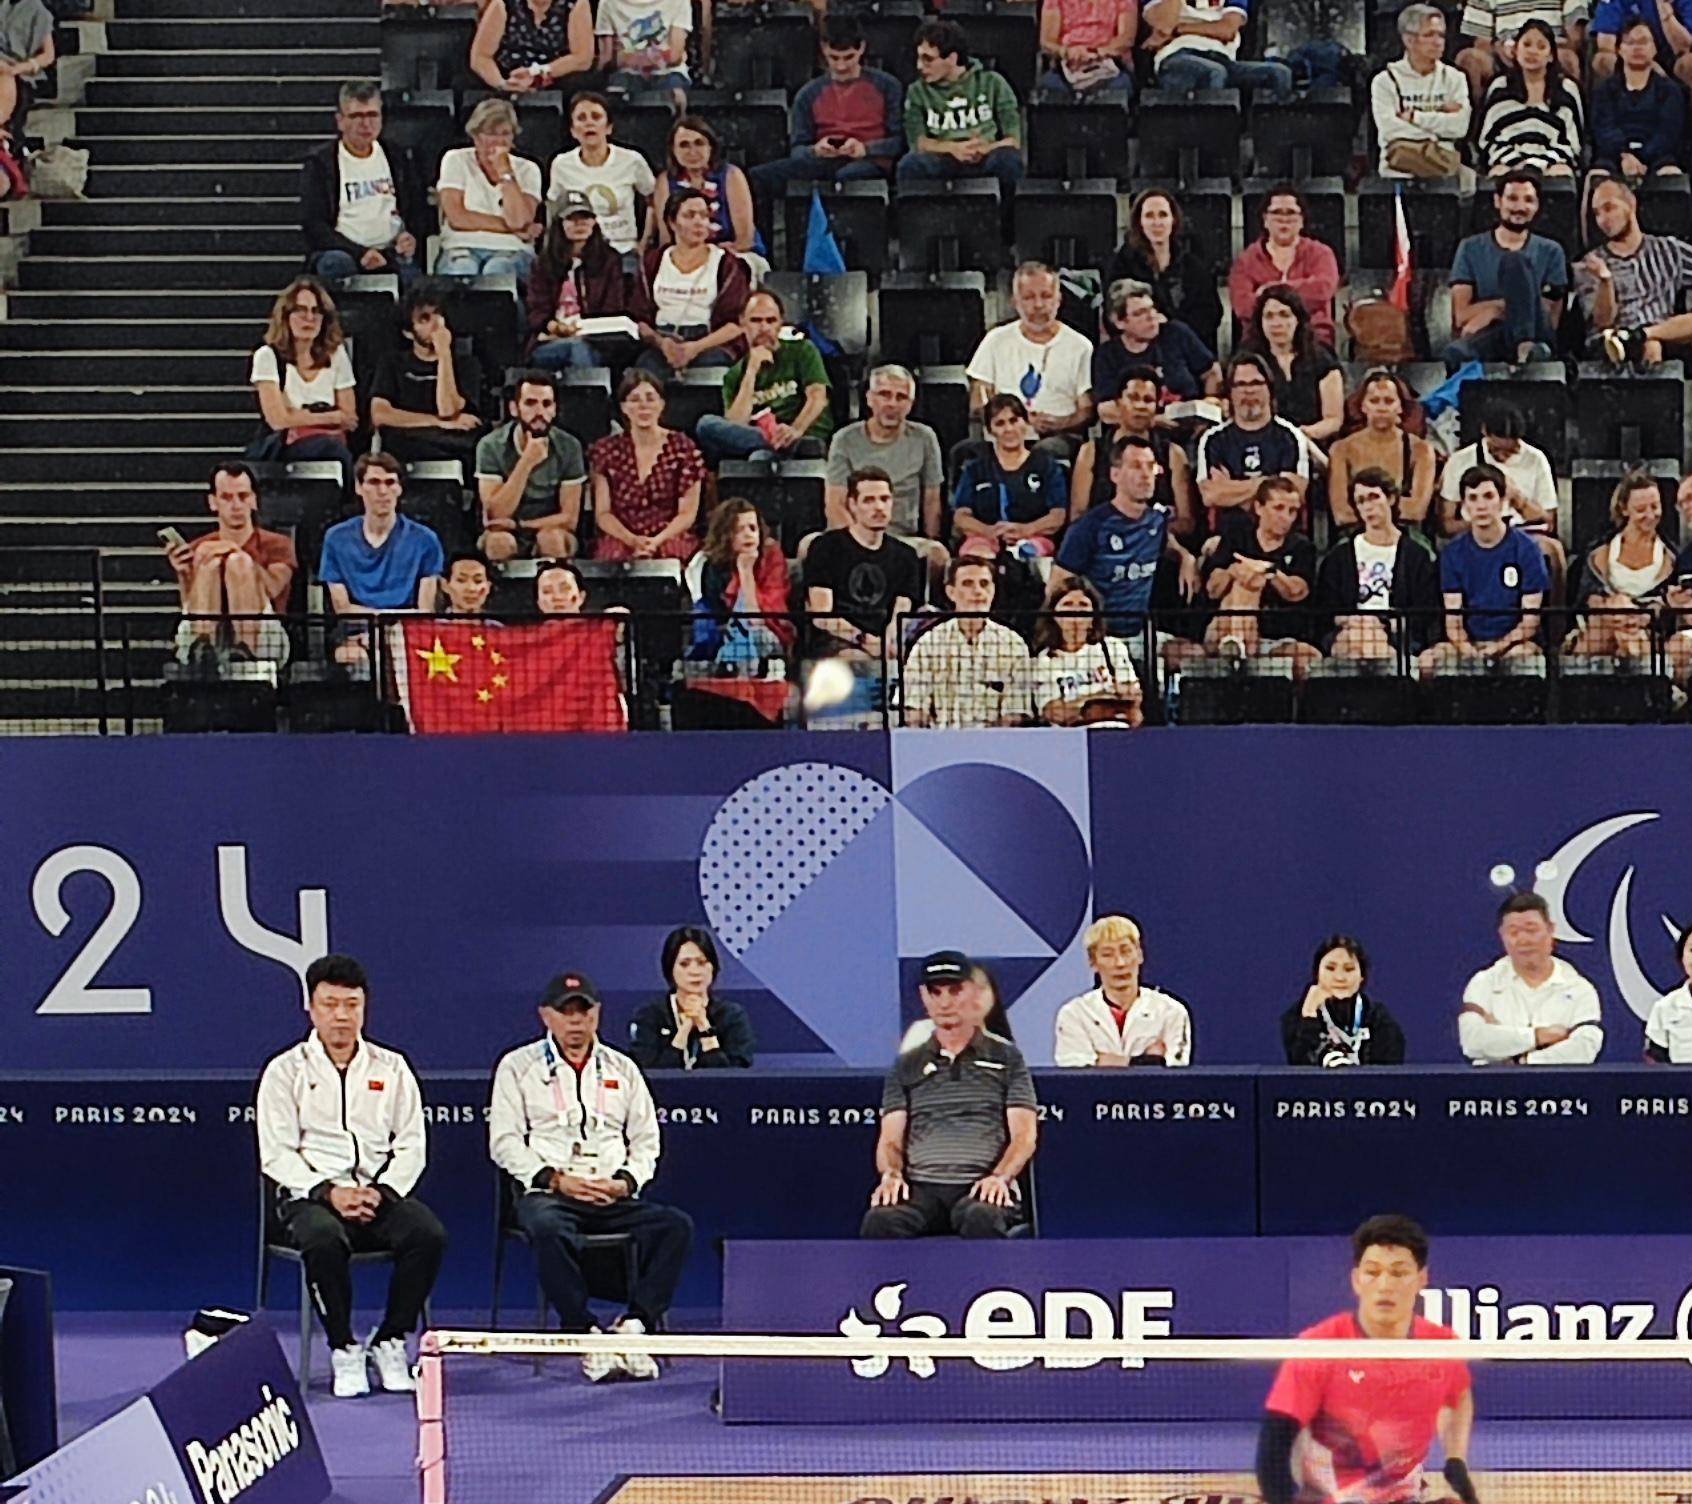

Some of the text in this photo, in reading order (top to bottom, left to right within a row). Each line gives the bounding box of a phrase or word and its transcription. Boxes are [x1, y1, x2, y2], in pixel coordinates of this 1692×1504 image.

[132, 1106, 197, 1123] 2024
[1036, 1104, 1064, 1121] 24
[1172, 1102, 1236, 1120] 2024
[1353, 1100, 1417, 1117] 2024
[1524, 1098, 1589, 1116] 2024
[1404, 1288, 1656, 1346] llianz
